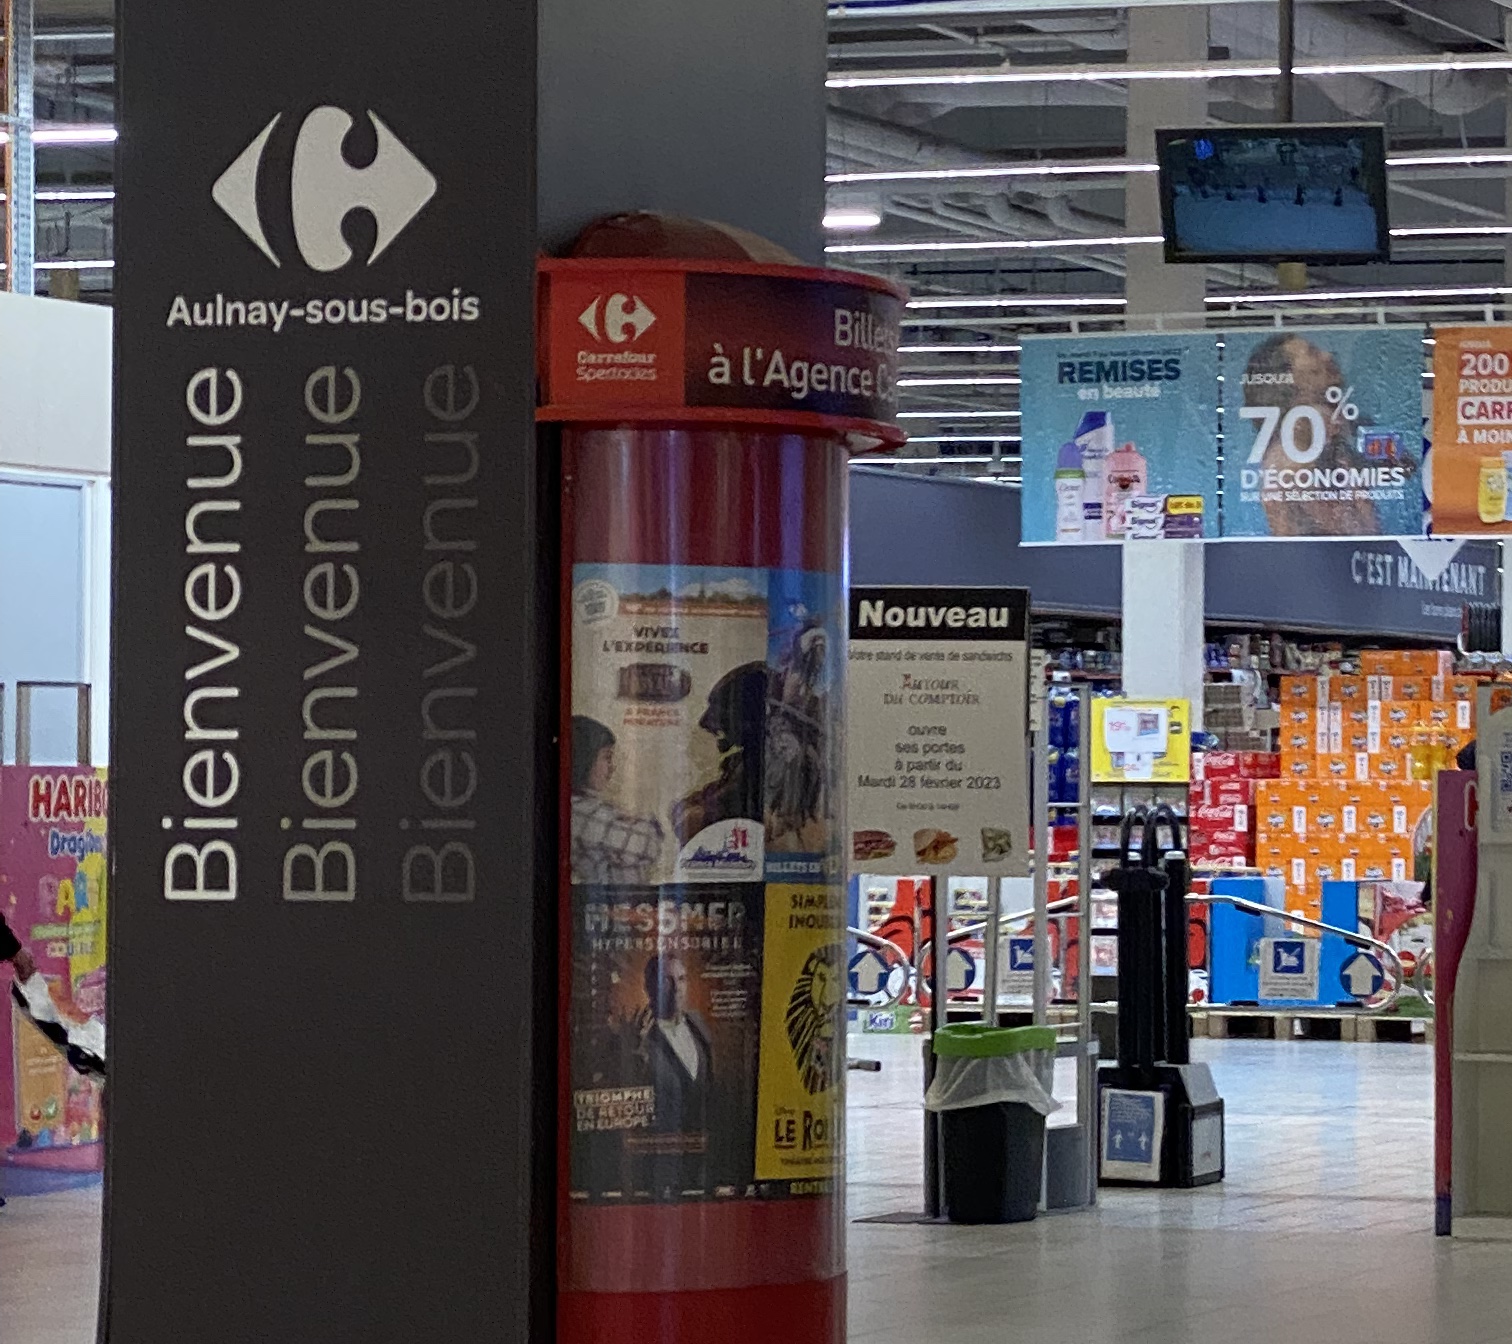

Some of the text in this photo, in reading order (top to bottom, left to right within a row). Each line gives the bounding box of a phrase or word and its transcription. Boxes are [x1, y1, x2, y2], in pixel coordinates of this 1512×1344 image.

[167, 289, 480, 332] Aulnay-sous-bois
[577, 350, 657, 364] Carrefour
[708, 342, 874, 400] à l'Agence
[1058, 358, 1182, 385] REMISES
[1461, 353, 1510, 376] 200
[1239, 385, 1359, 465] 70%
[1456, 426, 1470, 444] À
[1240, 462, 1406, 489] D'ÉCONOMIES
[1352, 550, 1393, 586] C'EST
[859, 600, 1009, 628] Nouveau
[162, 366, 243, 902] Bienvenue
[280, 365, 362, 903] Bienvenue
[400, 364, 480, 903] Bienvenue
[908, 725, 947, 737] ouvre
[29, 774, 108, 823] HARIB
